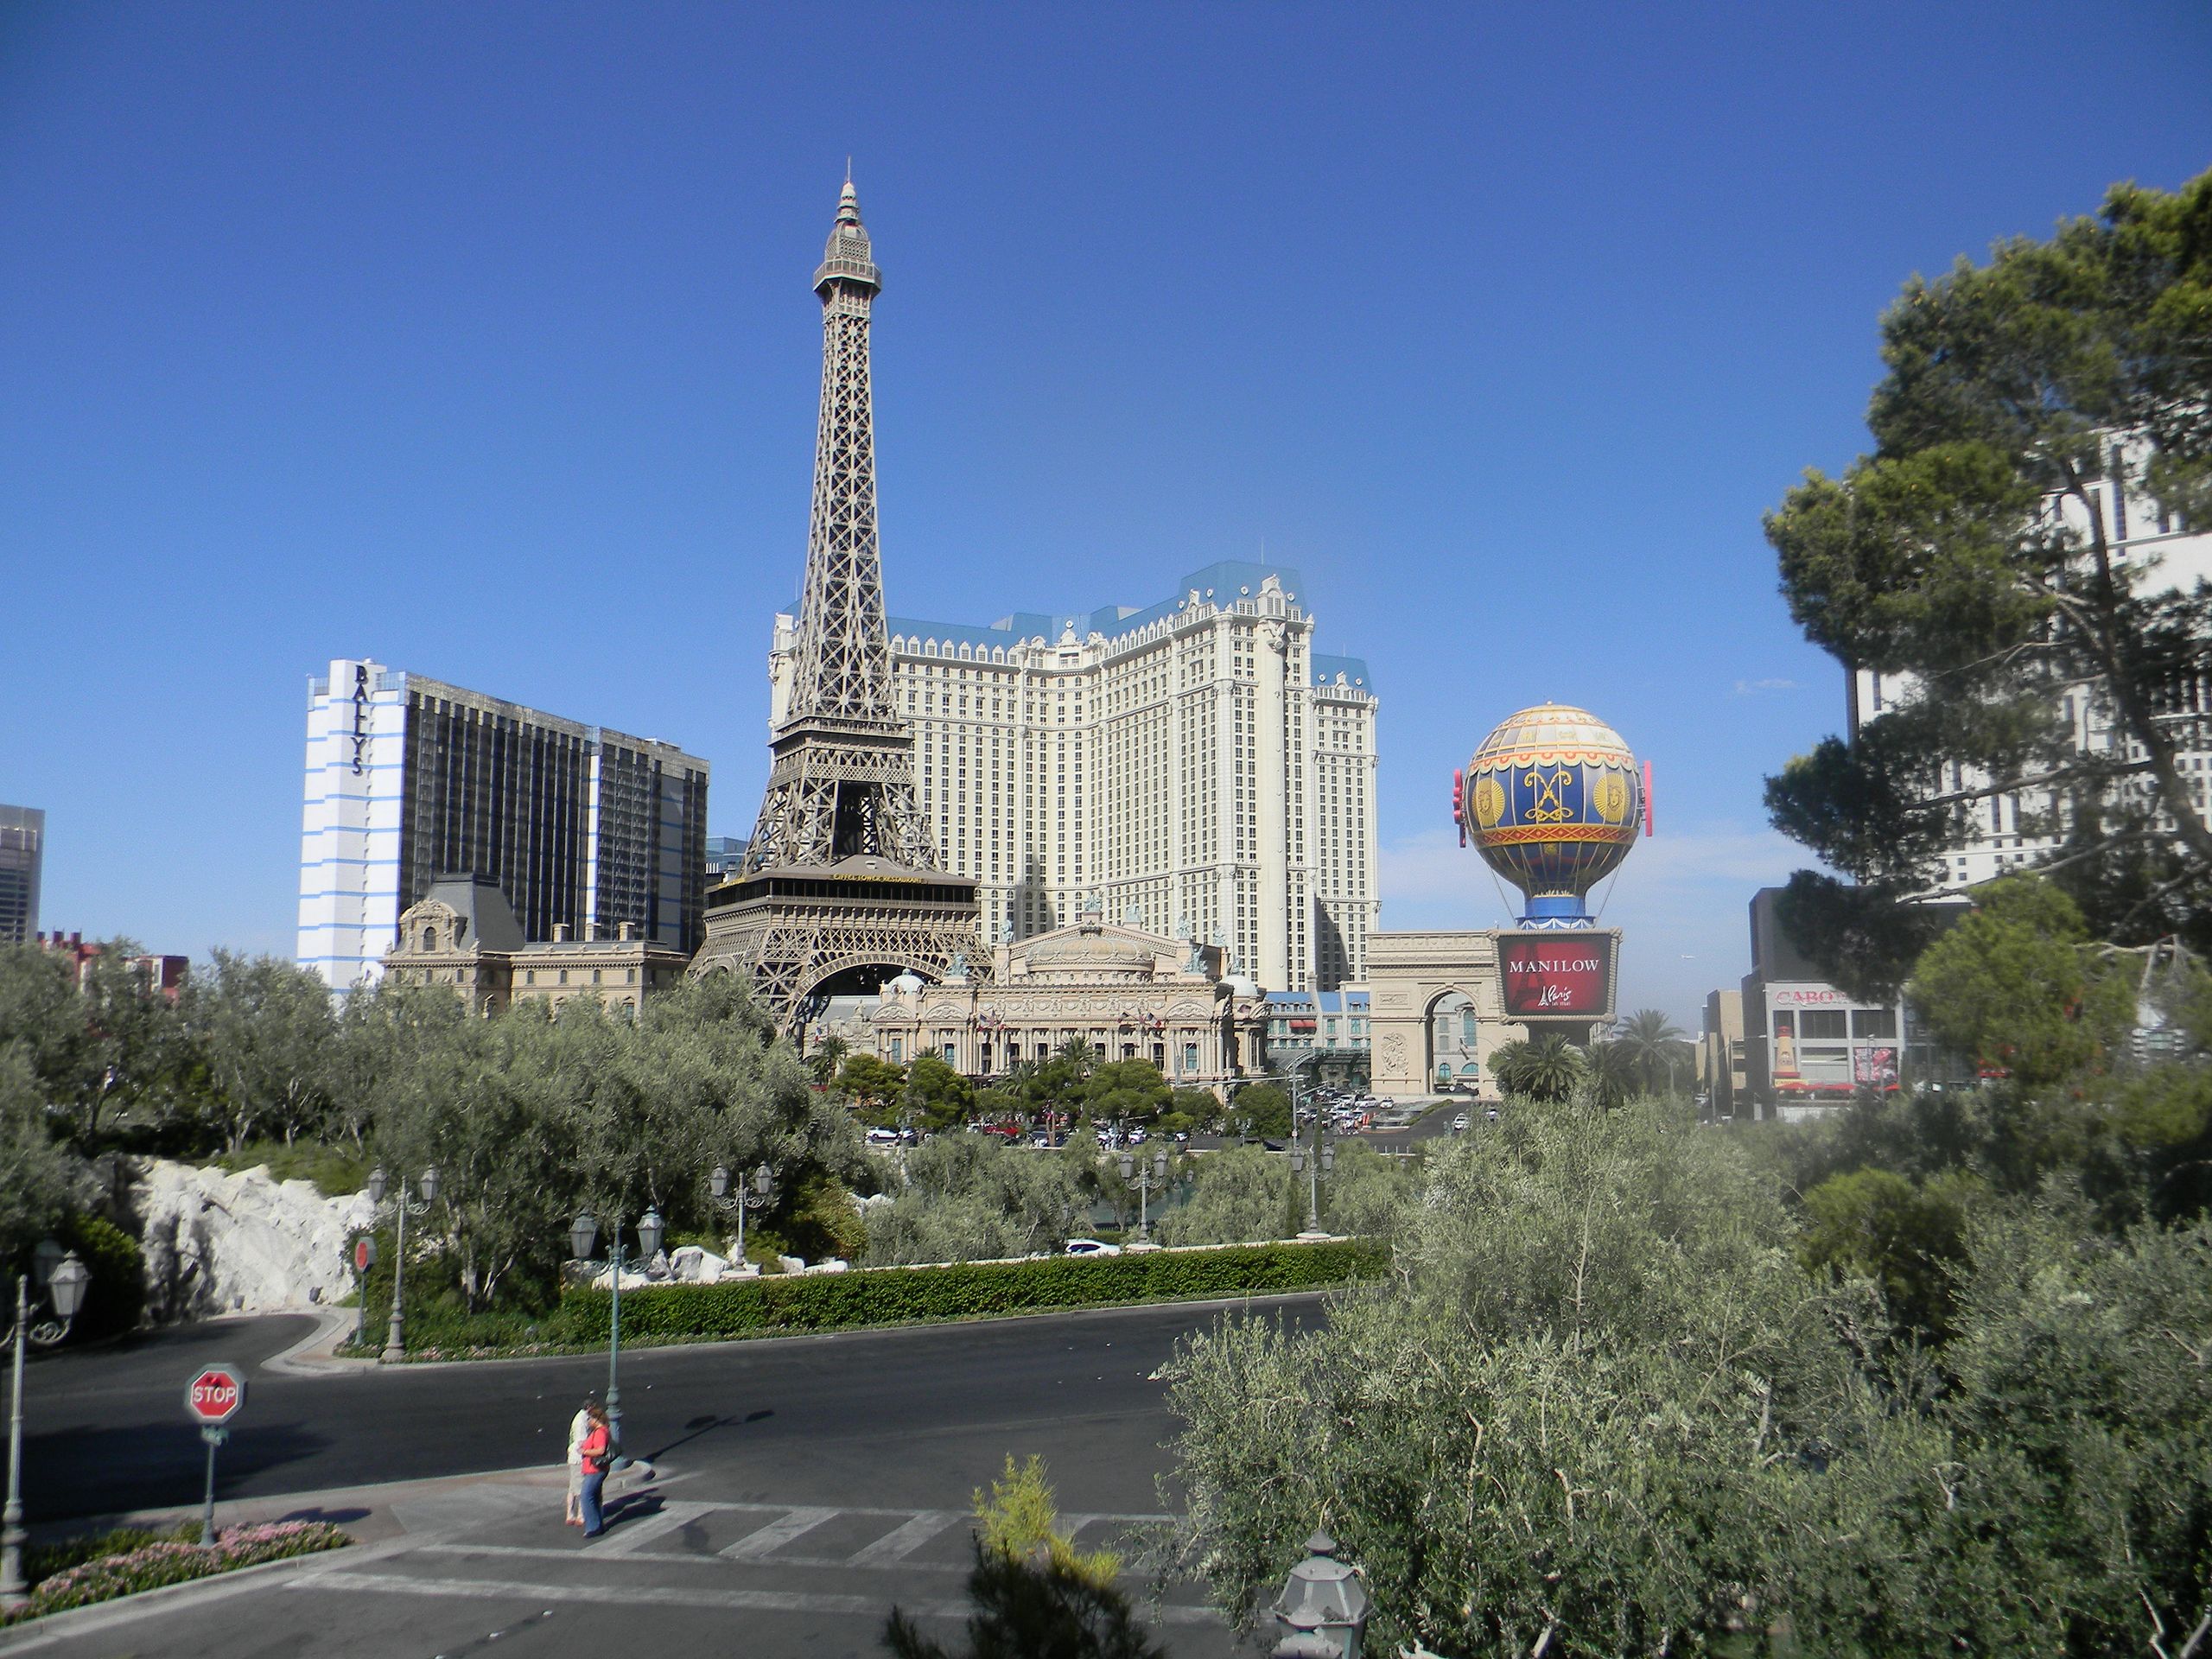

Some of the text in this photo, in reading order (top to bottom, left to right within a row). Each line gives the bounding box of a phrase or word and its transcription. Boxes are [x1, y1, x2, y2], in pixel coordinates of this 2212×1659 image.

[1509, 959, 1599, 973] MANILOW
[1548, 985, 1572, 1002] Paris
[1776, 989, 1834, 1005] CABO
[194, 1386, 236, 1403] STOP
